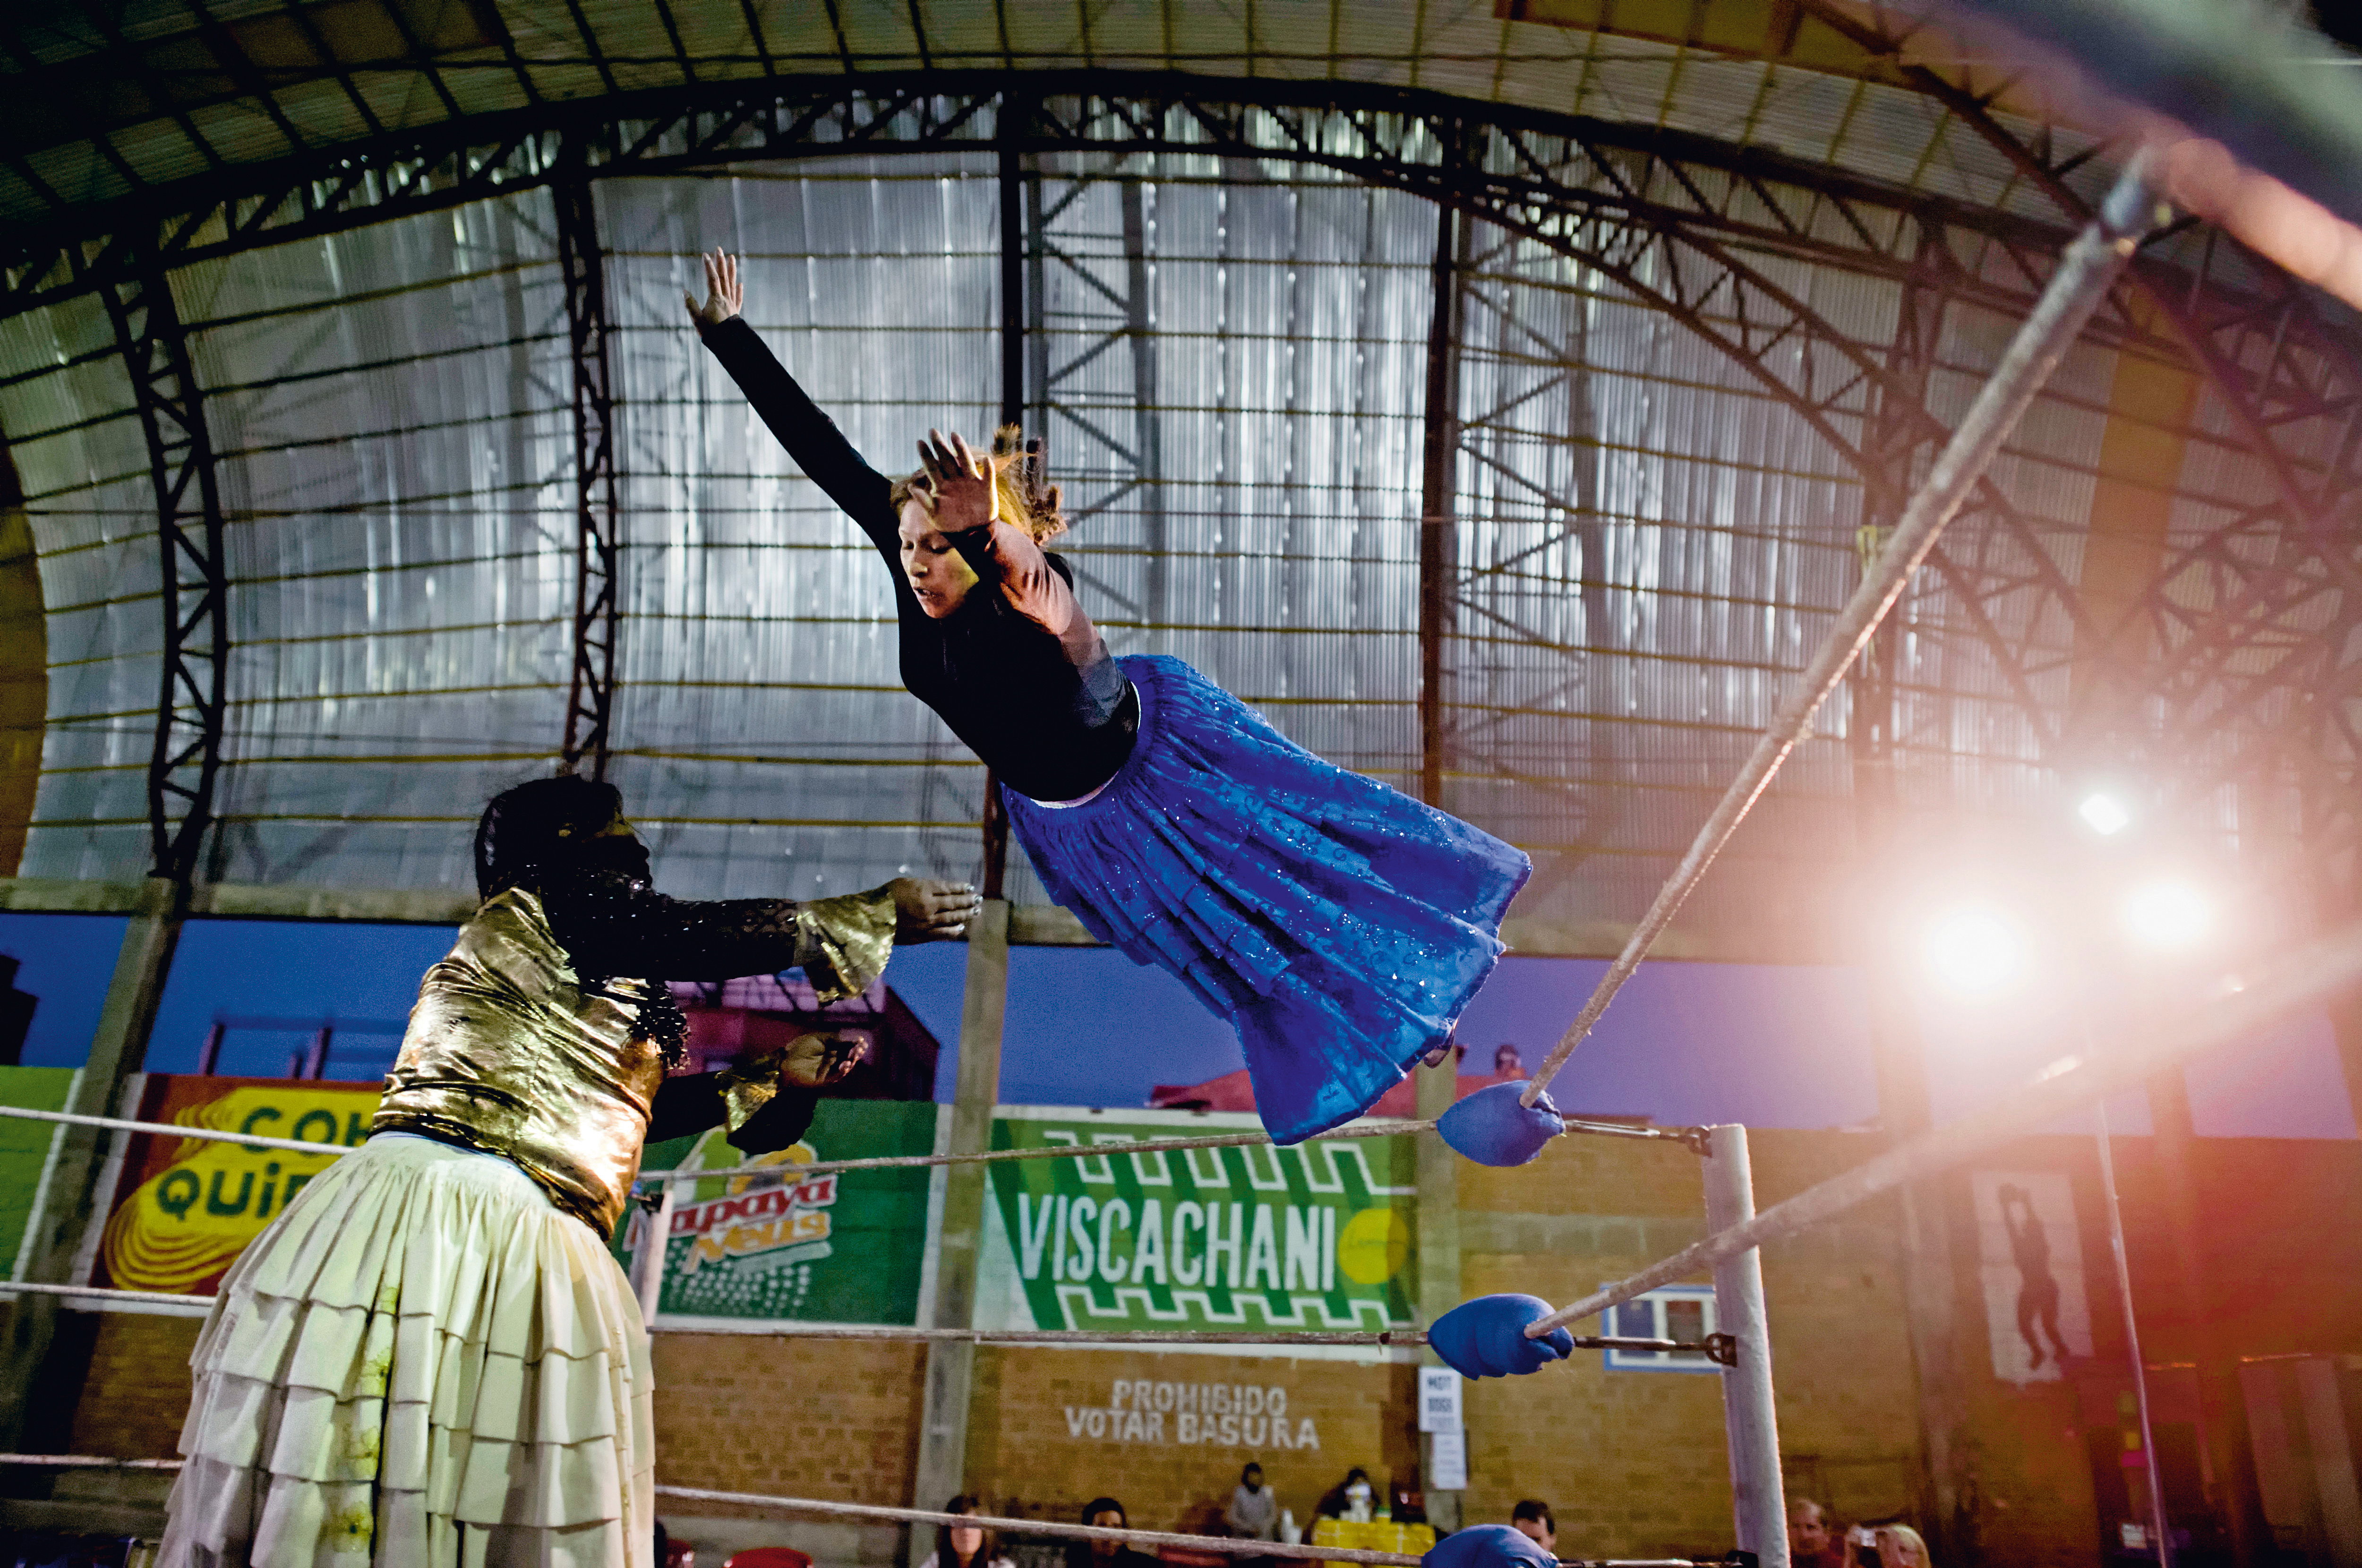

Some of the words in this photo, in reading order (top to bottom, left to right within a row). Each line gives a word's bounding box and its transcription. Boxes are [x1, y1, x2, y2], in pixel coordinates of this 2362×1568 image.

[1018, 1192, 1335, 1292] VISCACHANI
[1112, 1379, 1287, 1418] PROHIBIDO
[1064, 1406, 1164, 1443] VOTAR
[1177, 1413, 1320, 1450] BASURA
